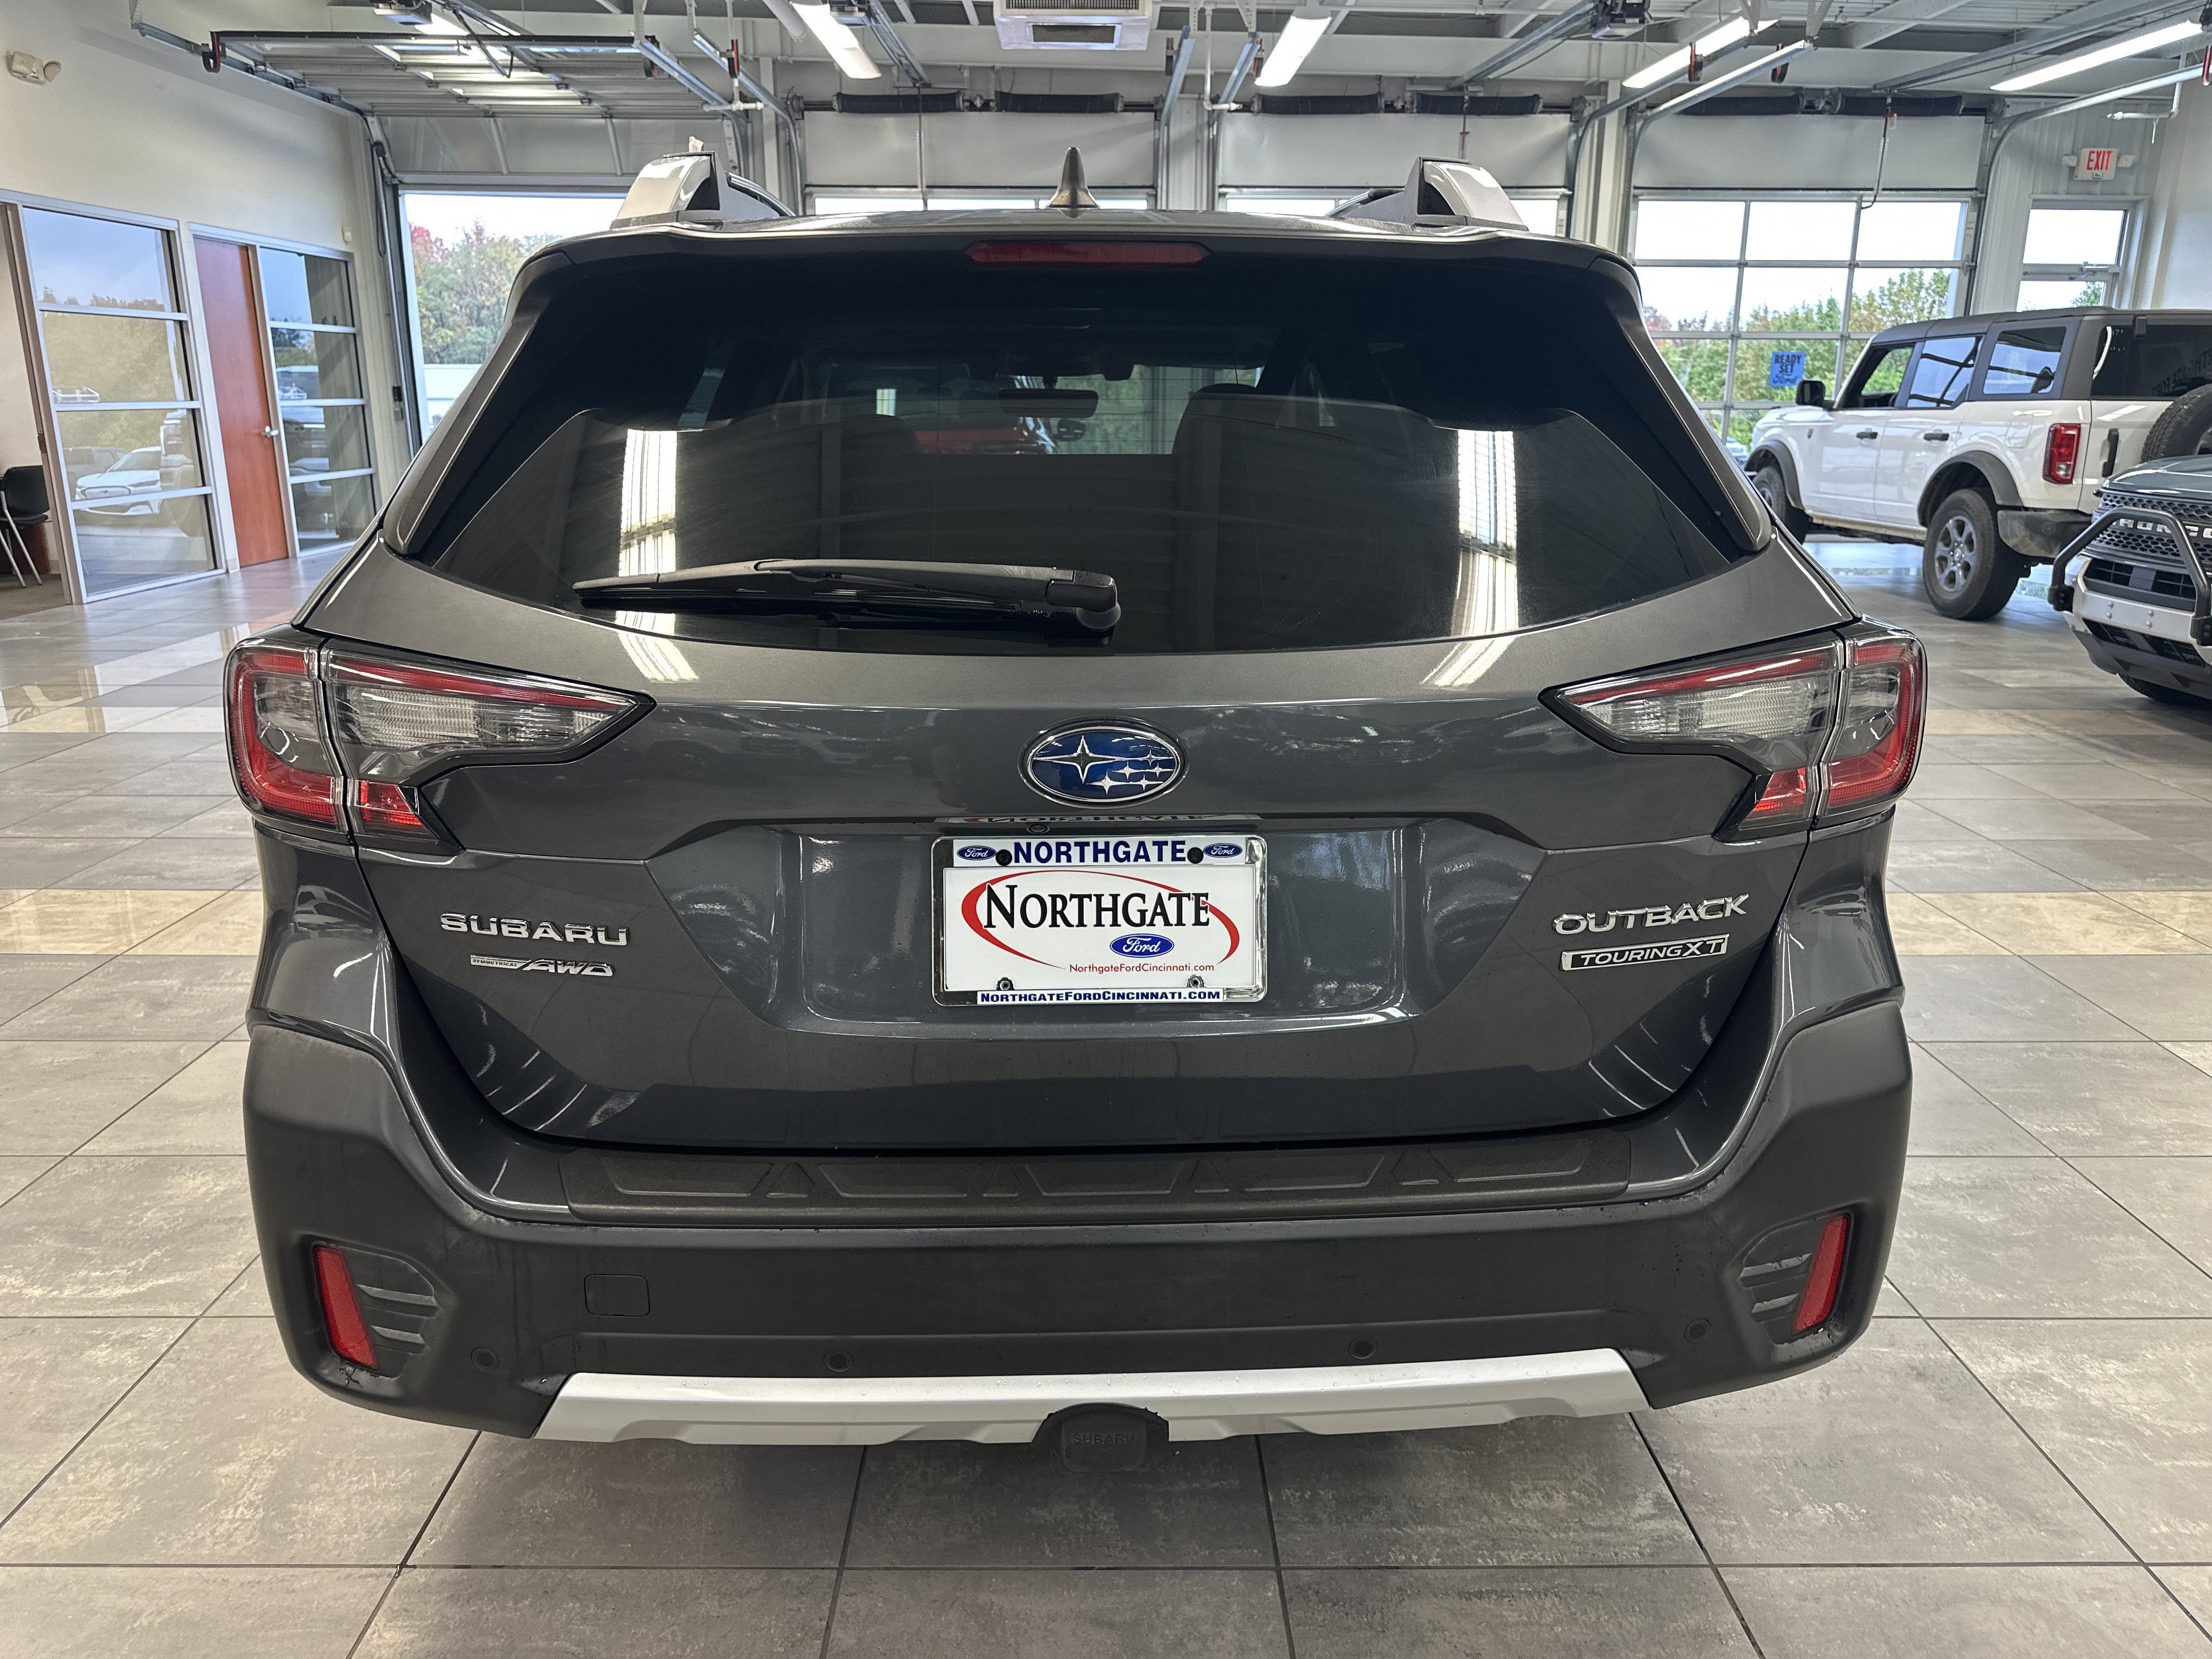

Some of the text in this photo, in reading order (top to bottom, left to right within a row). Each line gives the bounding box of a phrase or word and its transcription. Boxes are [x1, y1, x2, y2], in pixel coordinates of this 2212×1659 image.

[2086, 150, 2113, 170] EXIT
[1774, 354, 1802, 364] READY
[1779, 364, 1795, 374] SET
[2113, 518, 2212, 539] RONC
[964, 840, 1235, 864] Ford NORTHGATE Ford
[1552, 894, 1749, 935] OUTBACK
[441, 912, 628, 946] SUBARU
[1122, 936, 1161, 953] Ford
[472, 958, 615, 977] SYMMETRICAL AWD
[1069, 963, 1214, 974] NorthgateFordCincinnati.com
[1073, 1432, 1135, 1444] SUBARU
